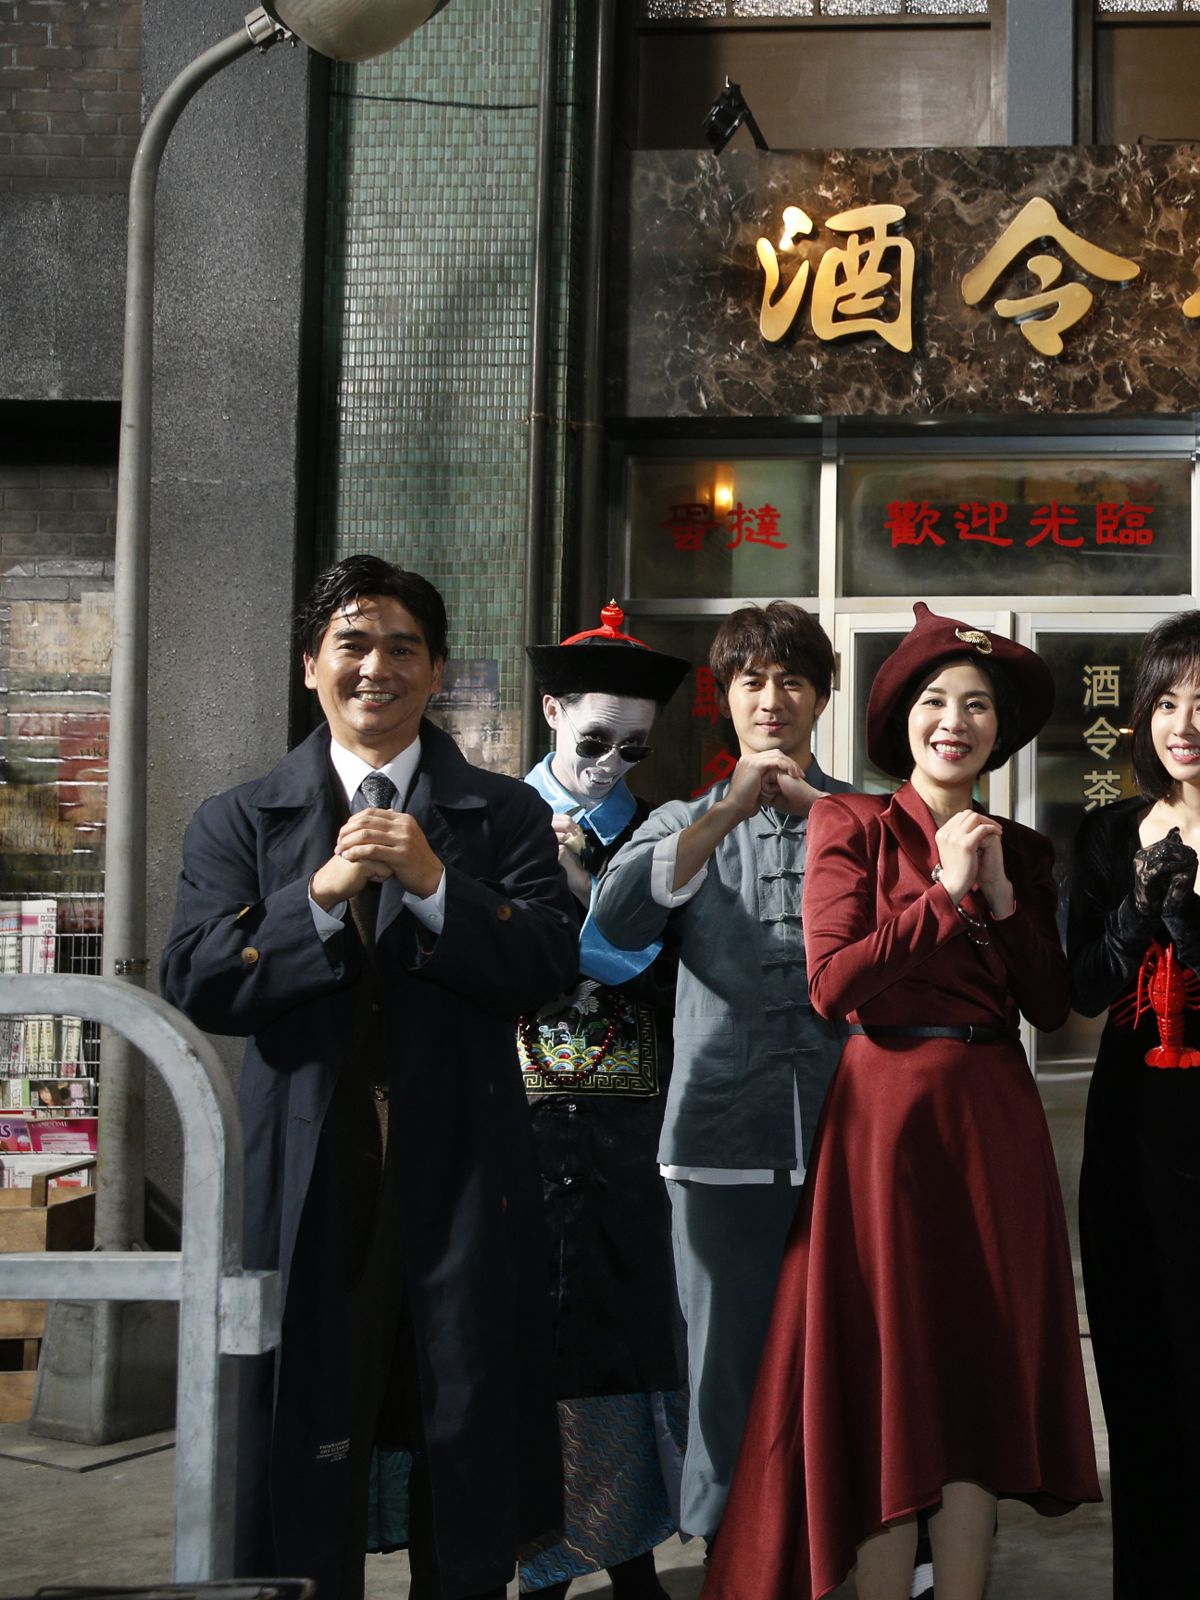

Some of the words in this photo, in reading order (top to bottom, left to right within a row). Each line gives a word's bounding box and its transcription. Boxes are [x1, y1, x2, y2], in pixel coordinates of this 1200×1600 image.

[884, 499, 1154, 549] 歡迎光臨
[1083, 664, 1122, 812] 酒令茶
